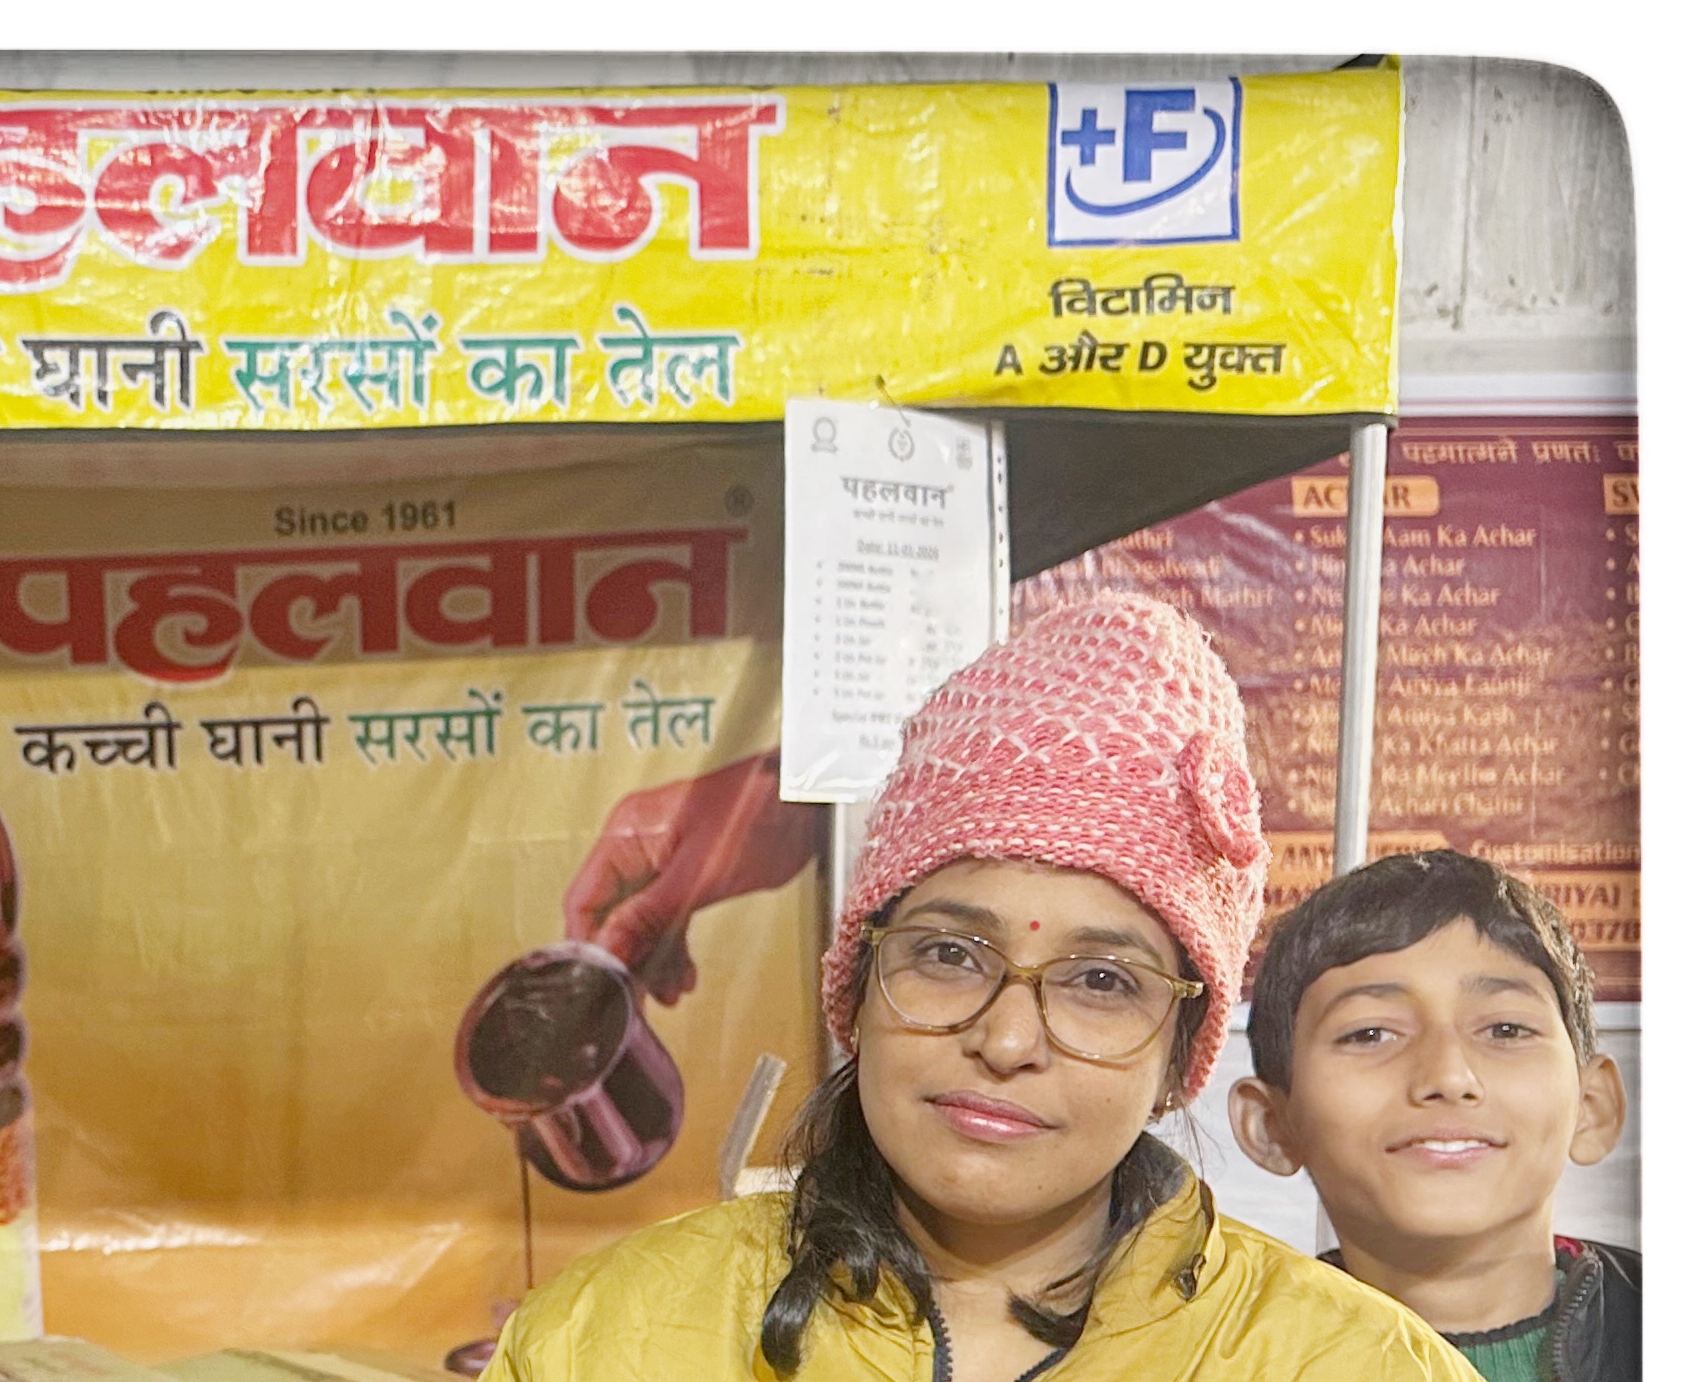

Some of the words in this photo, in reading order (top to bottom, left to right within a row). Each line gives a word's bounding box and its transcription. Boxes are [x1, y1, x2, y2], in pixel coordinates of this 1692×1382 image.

[1048, 273, 1235, 317] विटामिन
[22, 311, 201, 408] घानी
[226, 310, 436, 409] सरसों
[460, 335, 578, 405] का
[601, 307, 738, 405] तेल
[994, 343, 1024, 375] A
[1040, 329, 1129, 375] और
[1138, 341, 1167, 372] D
[1183, 343, 1286, 391] युक्त
[840, 475, 948, 509] पहलवान
[274, 507, 368, 537] Since
[384, 501, 457, 532] 1961
[1384, 524, 1430, 548] Aam
[1437, 524, 1468, 548] Ka
[1473, 523, 1537, 548] Achar
[1403, 553, 1466, 577] Achar
[1401, 583, 1432, 606] Ka
[1437, 582, 1502, 606] Achar
[1414, 613, 1477, 637] Achar
[1490, 641, 1554, 668] Achar
[15, 702, 181, 772] कच्ची
[201, 697, 330, 766] घानी
[349, 689, 504, 763] सरसों
[523, 702, 604, 753] का
[624, 682, 716, 748] तेल
